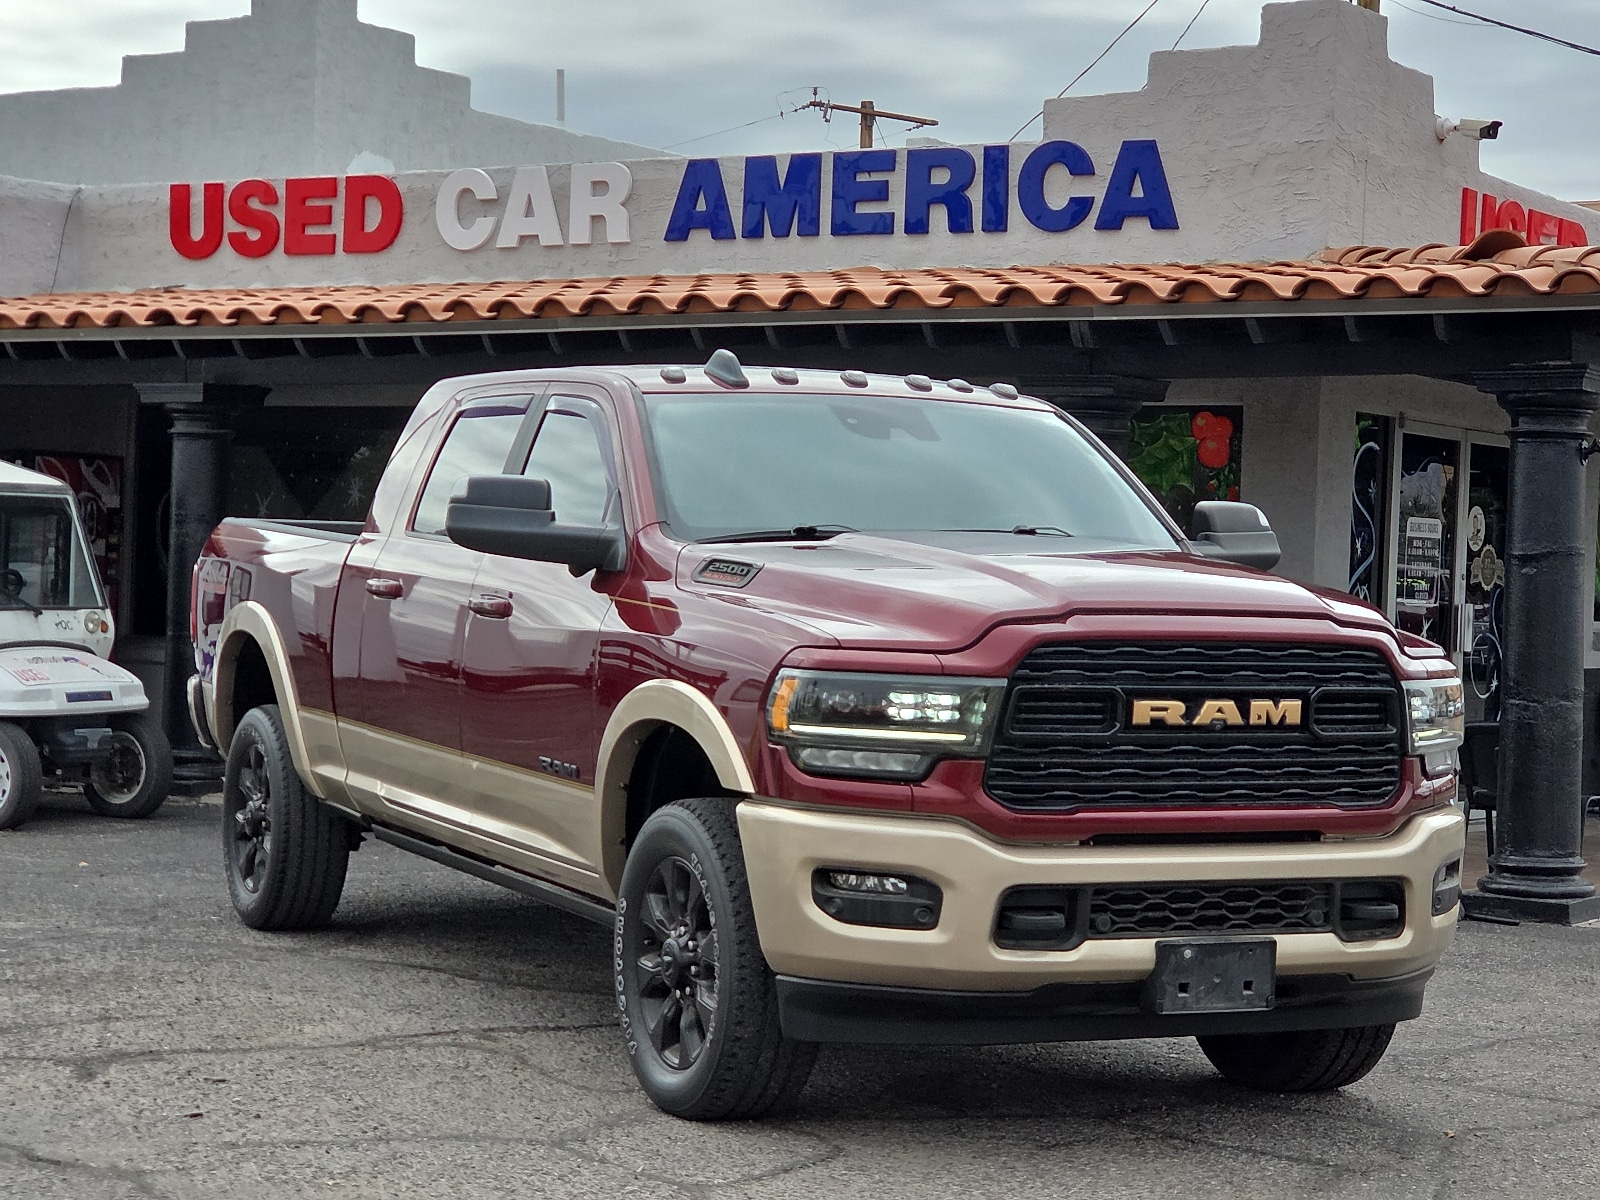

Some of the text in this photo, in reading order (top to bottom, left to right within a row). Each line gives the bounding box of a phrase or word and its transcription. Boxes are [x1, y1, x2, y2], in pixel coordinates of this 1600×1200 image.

[169, 139, 1180, 260] USED CAR AMERICA
[708, 561, 748, 575] 2500
[1132, 698, 1302, 727] RAM
[538, 755, 579, 779] RAM
